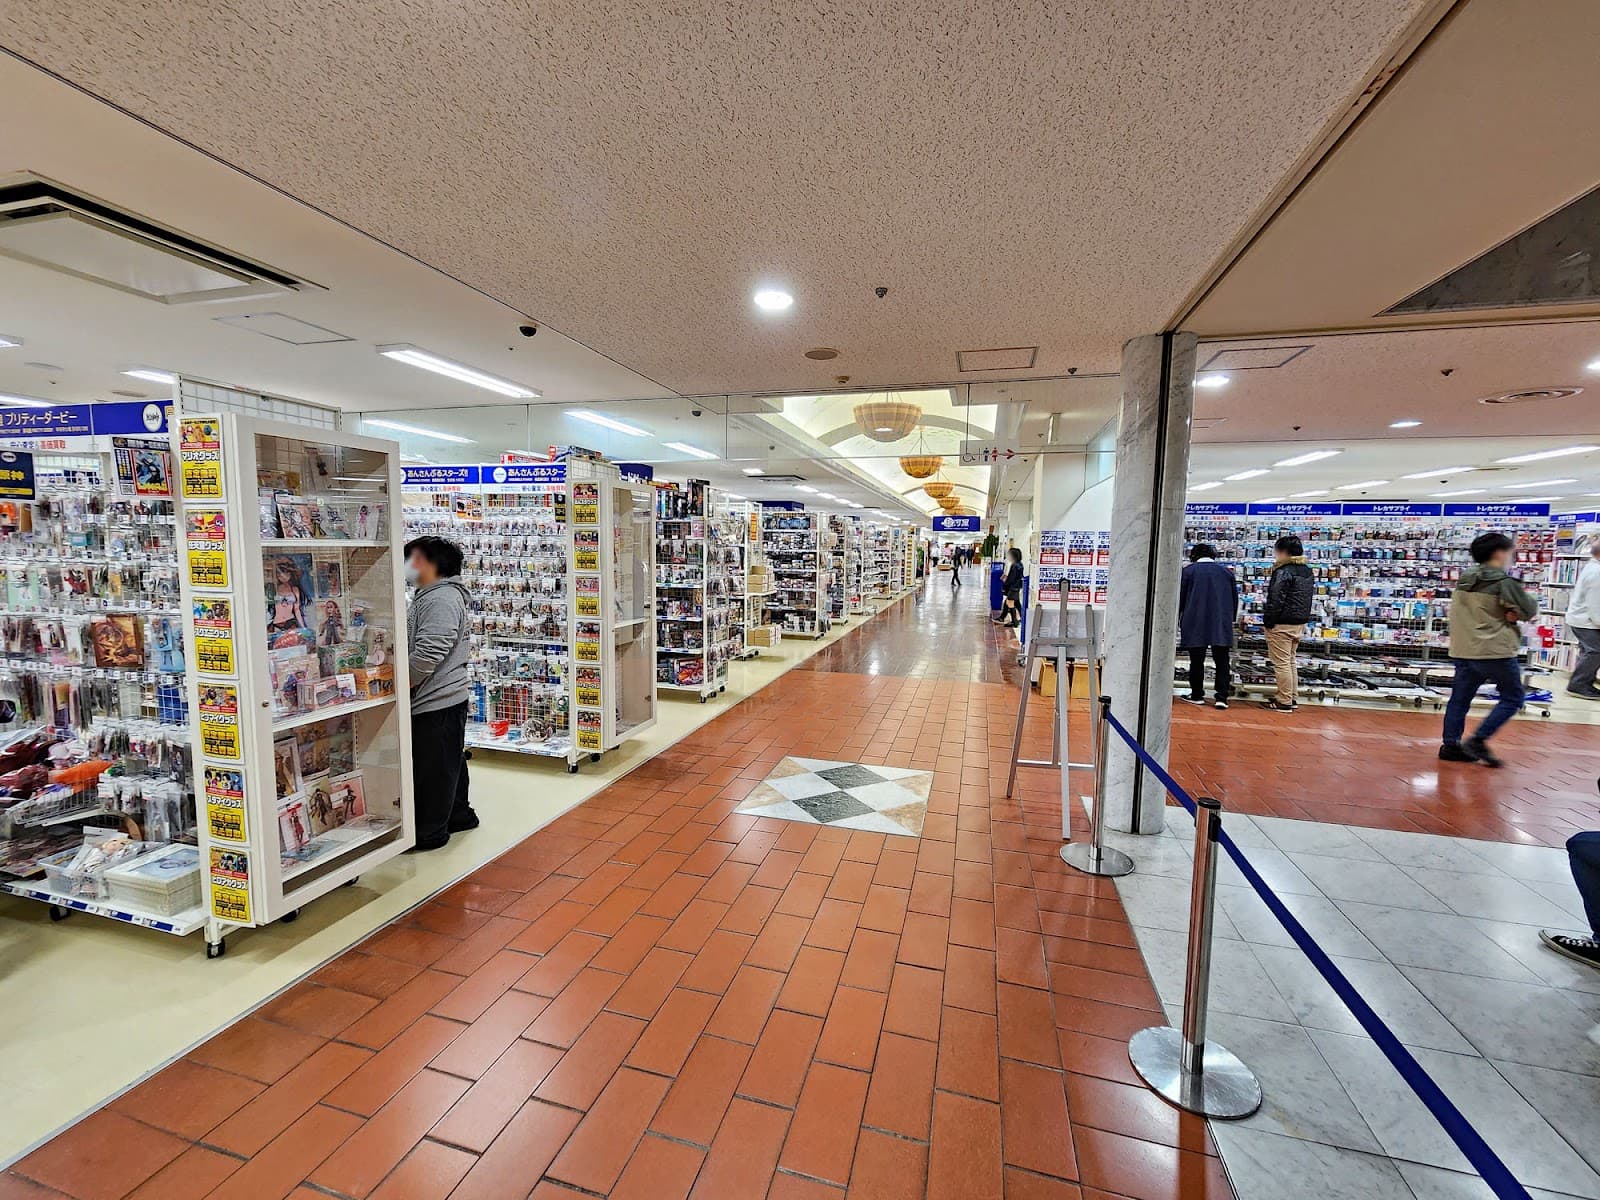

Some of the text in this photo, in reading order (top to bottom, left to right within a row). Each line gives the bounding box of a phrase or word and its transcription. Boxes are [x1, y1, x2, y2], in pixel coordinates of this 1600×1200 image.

[1372, 504, 1411, 512] トレカサプライ
[1476, 504, 1518, 512] トレカサプライ
